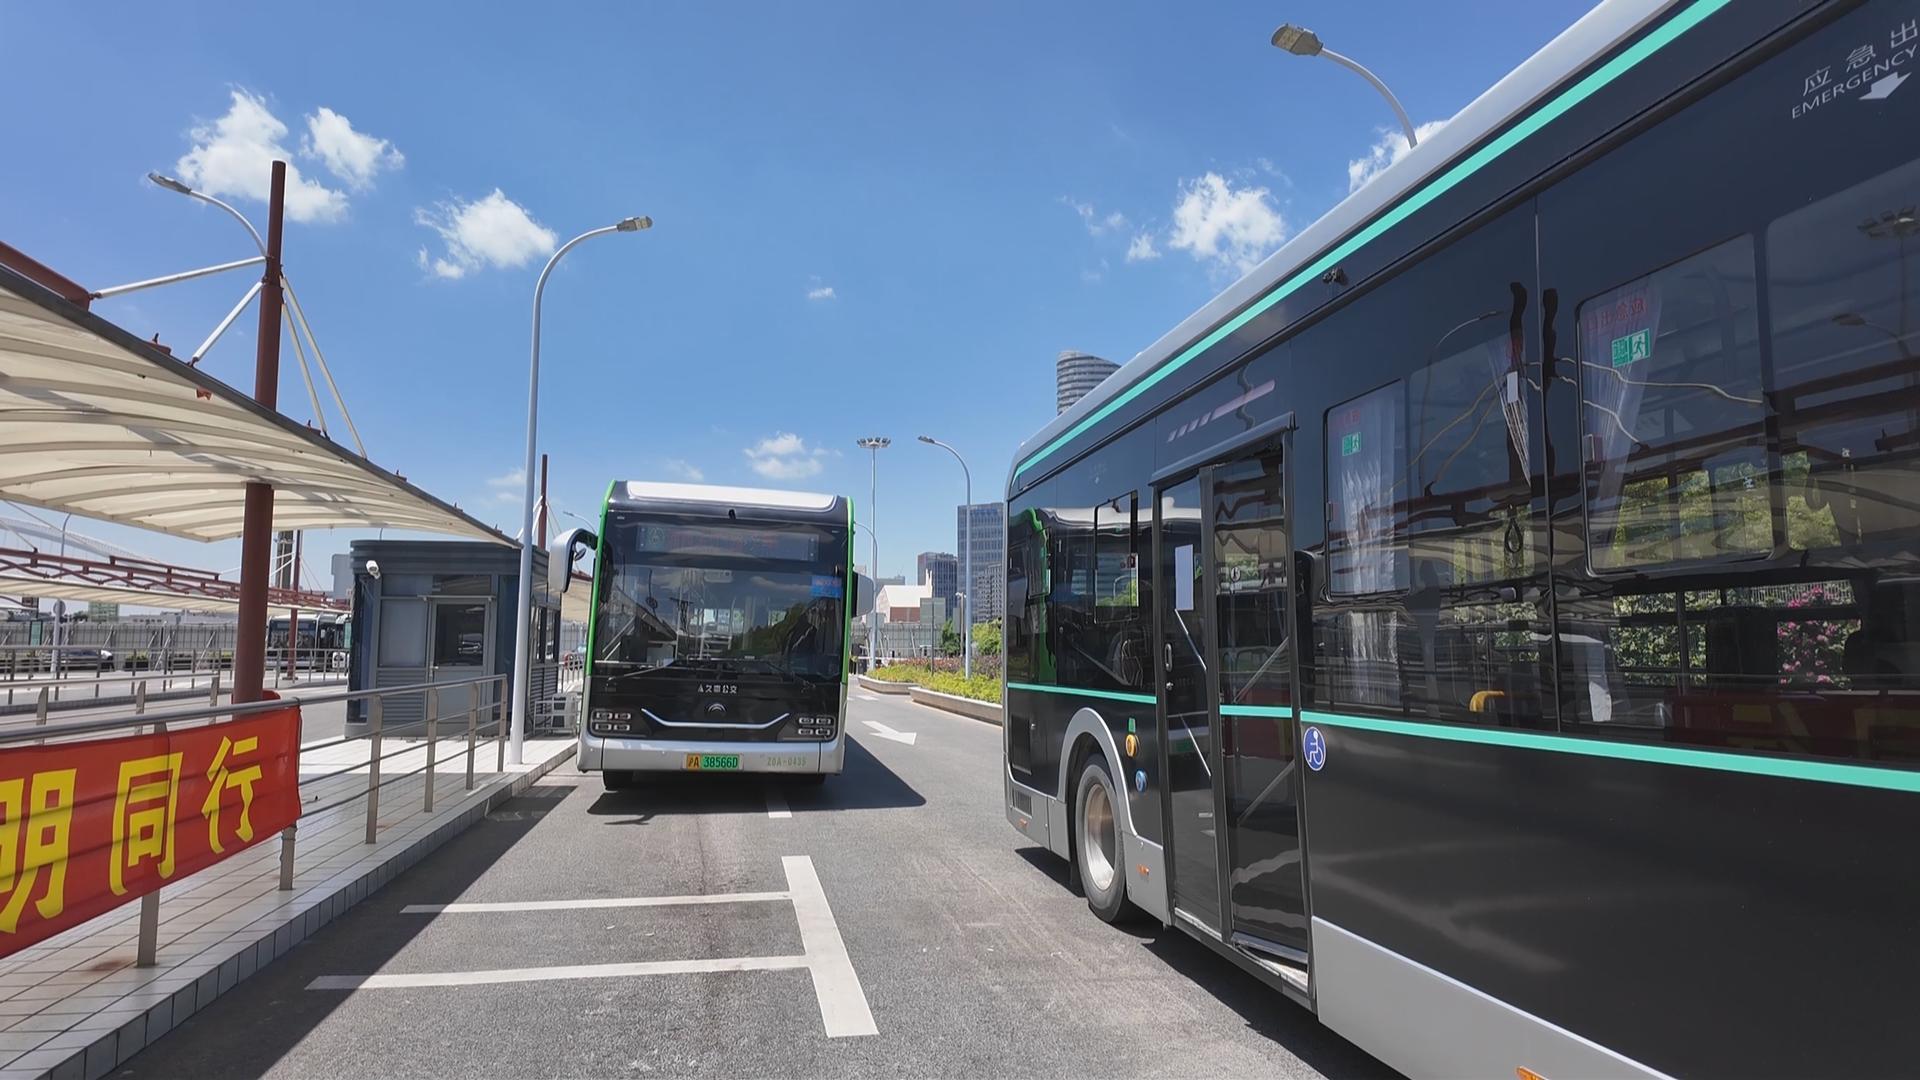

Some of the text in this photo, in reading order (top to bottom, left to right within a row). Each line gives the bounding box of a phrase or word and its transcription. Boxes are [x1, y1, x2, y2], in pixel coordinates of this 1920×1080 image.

[1792, 44, 1918, 119] EMERGENCY
[0, 736, 263, 934] 明同行
